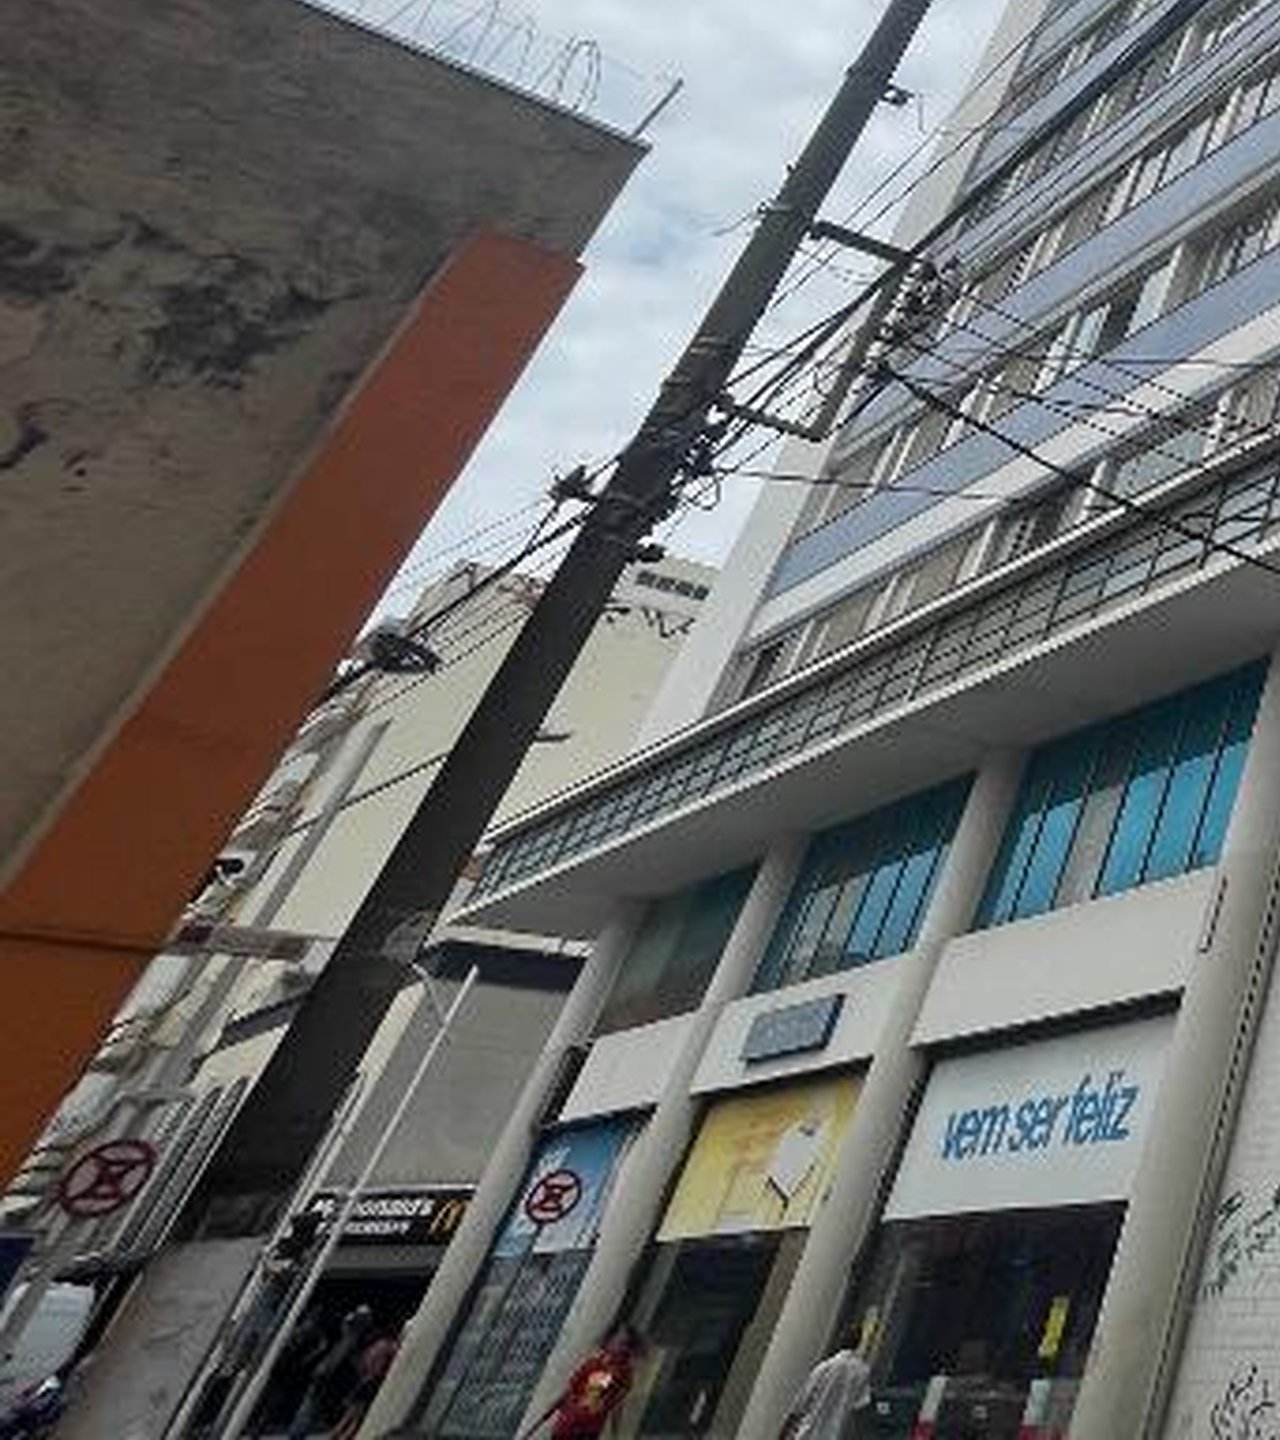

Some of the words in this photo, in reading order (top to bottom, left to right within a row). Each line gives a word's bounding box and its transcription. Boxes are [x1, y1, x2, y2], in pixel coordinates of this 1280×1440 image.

[942, 1103, 1010, 1159] vem
[1008, 1097, 1069, 1151] ser
[1063, 1070, 1139, 1145] feliz
